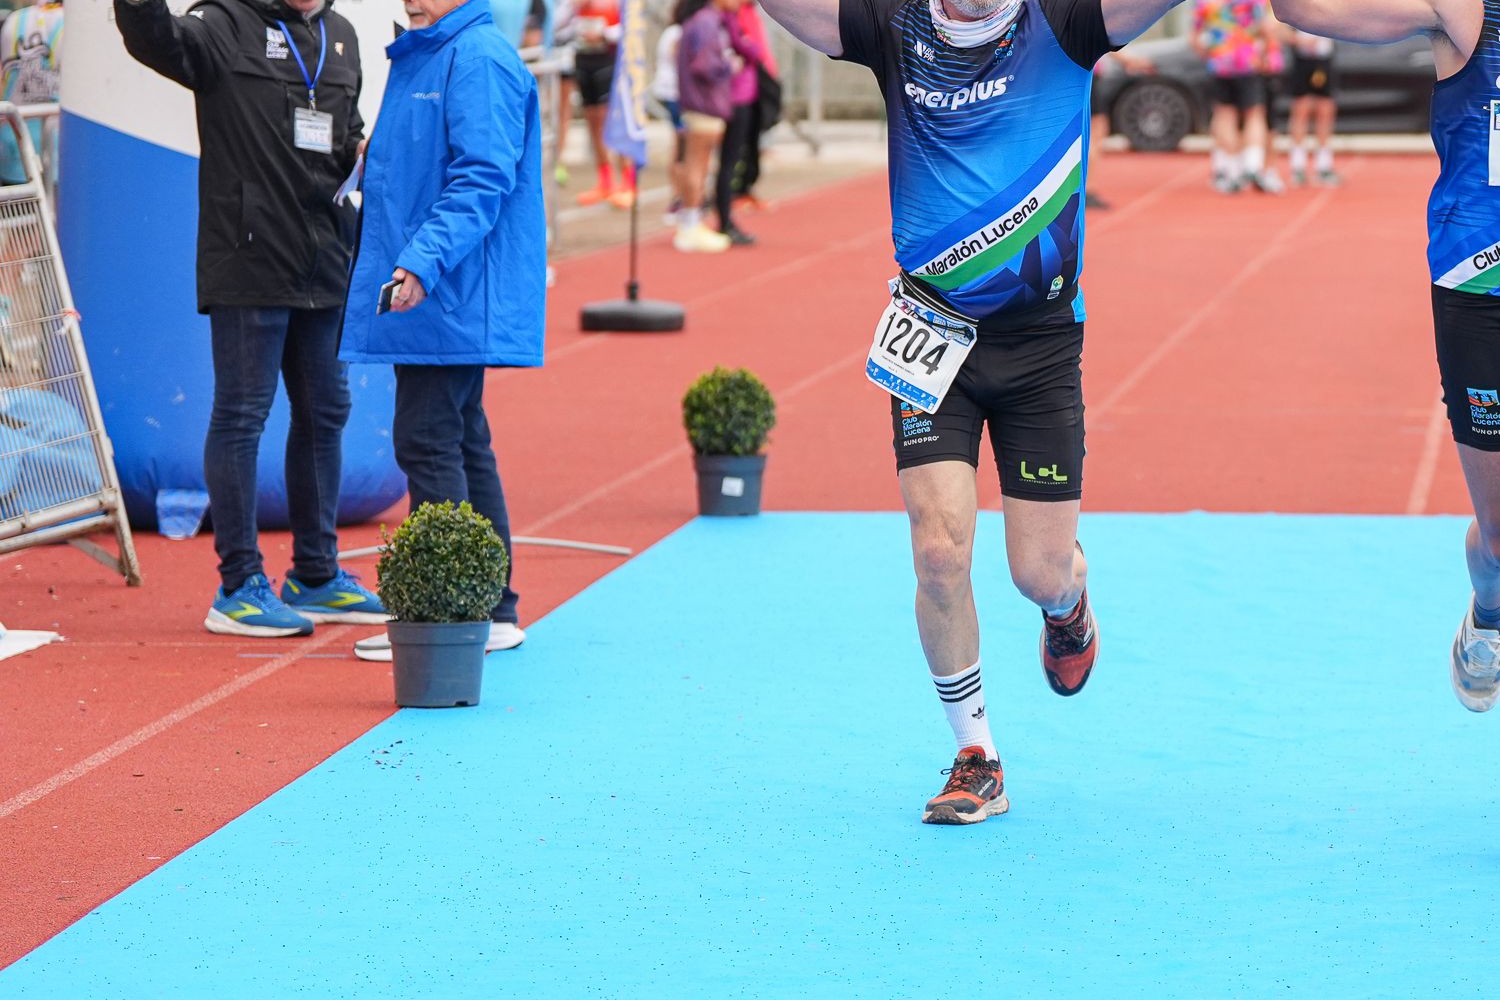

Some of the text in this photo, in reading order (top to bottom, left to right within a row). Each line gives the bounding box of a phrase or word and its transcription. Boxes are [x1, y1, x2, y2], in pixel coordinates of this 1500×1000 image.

[904, 77, 1008, 110] enerplus
[925, 196, 1039, 275] Maratón Lucena
[880, 312, 950, 375] 1204
[1470, 405, 1487, 413] Club
[902, 417, 918, 426] Club
[903, 419, 932, 430] Maratón
[903, 427, 931, 437] Lucena
